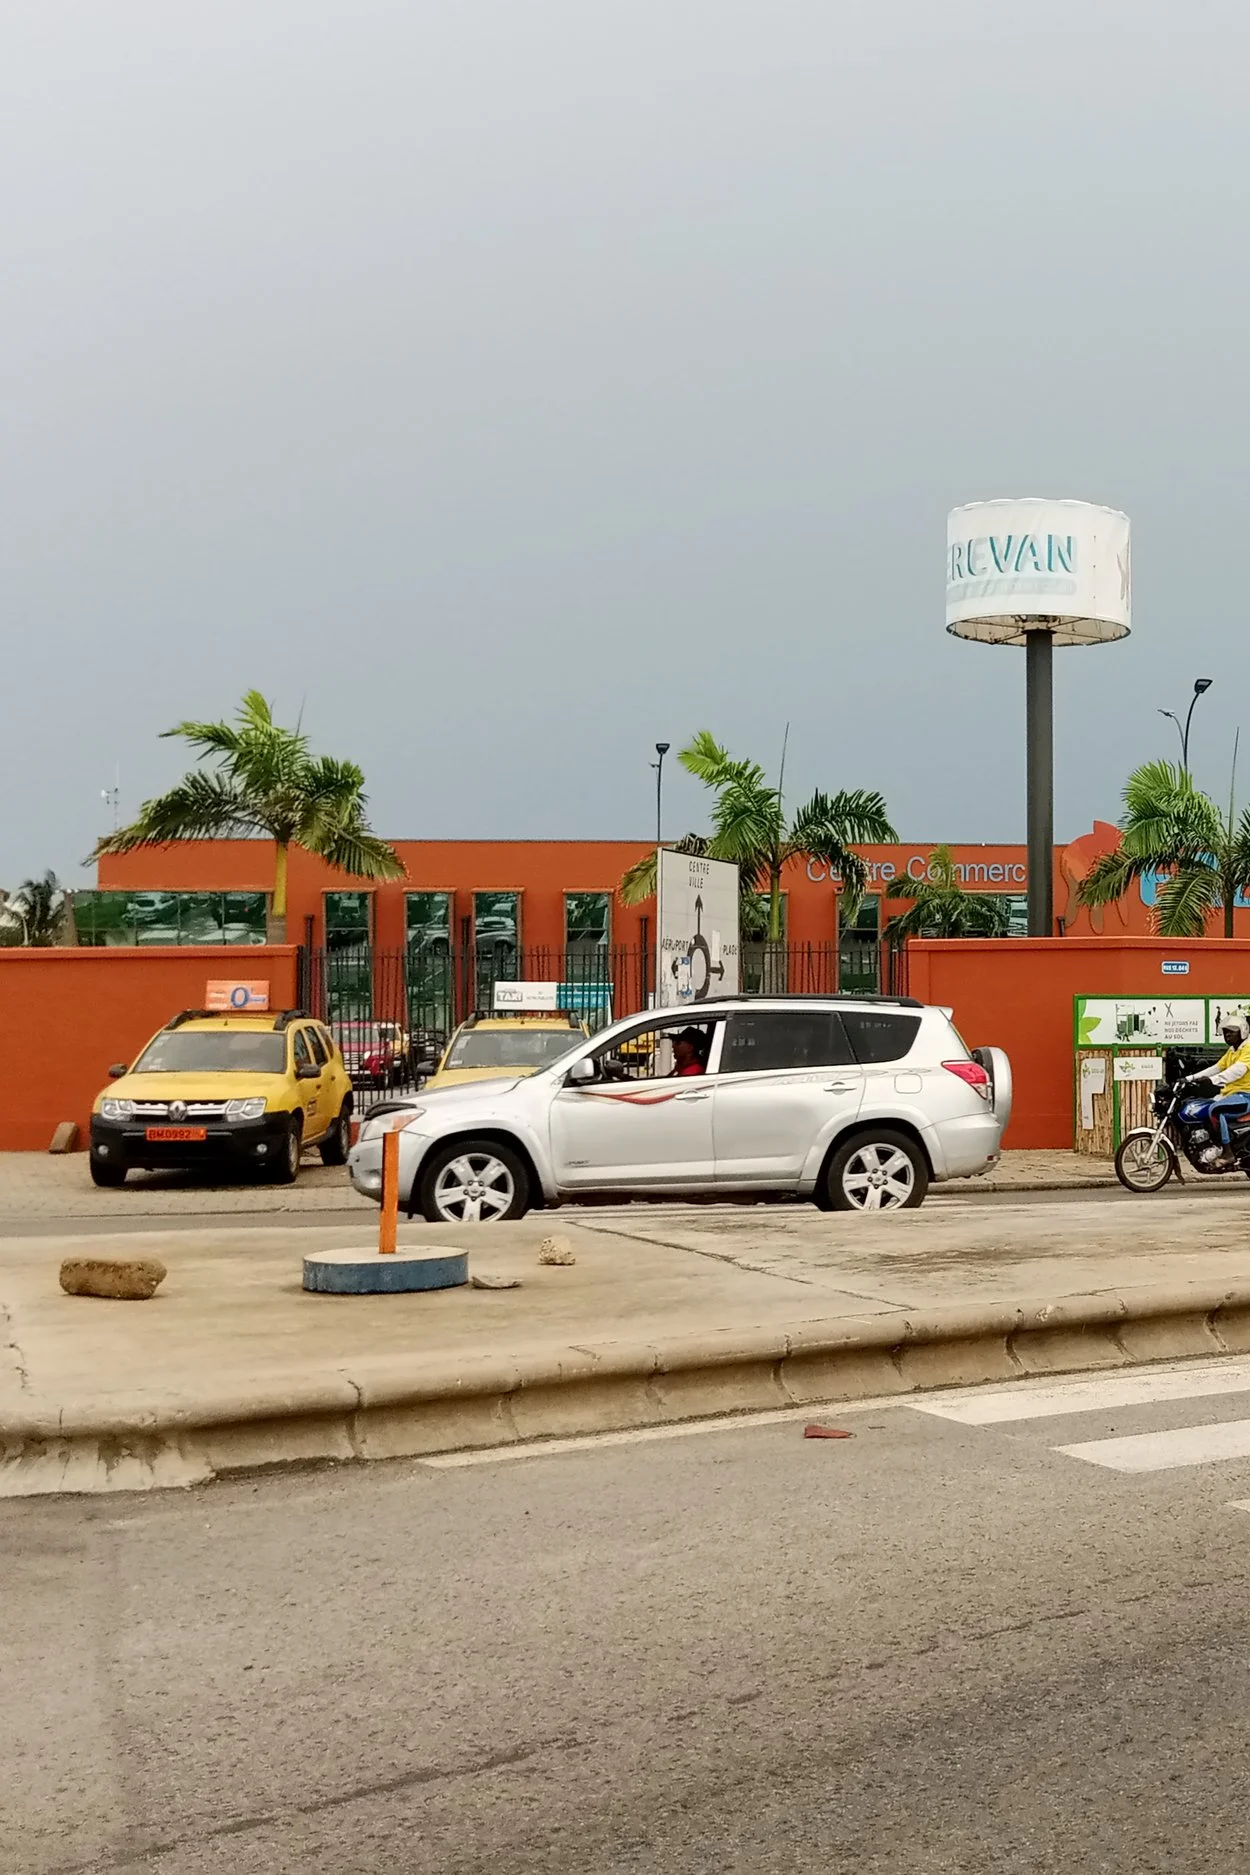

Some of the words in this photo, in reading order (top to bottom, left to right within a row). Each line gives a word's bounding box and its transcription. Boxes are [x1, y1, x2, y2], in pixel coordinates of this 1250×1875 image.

[950, 533, 1078, 581] REVAN
[688, 860, 710, 875] CENTRE
[806, 856, 896, 882] Cetre
[688, 877, 704, 889] VILLE
[497, 991, 523, 1002] TAXI
